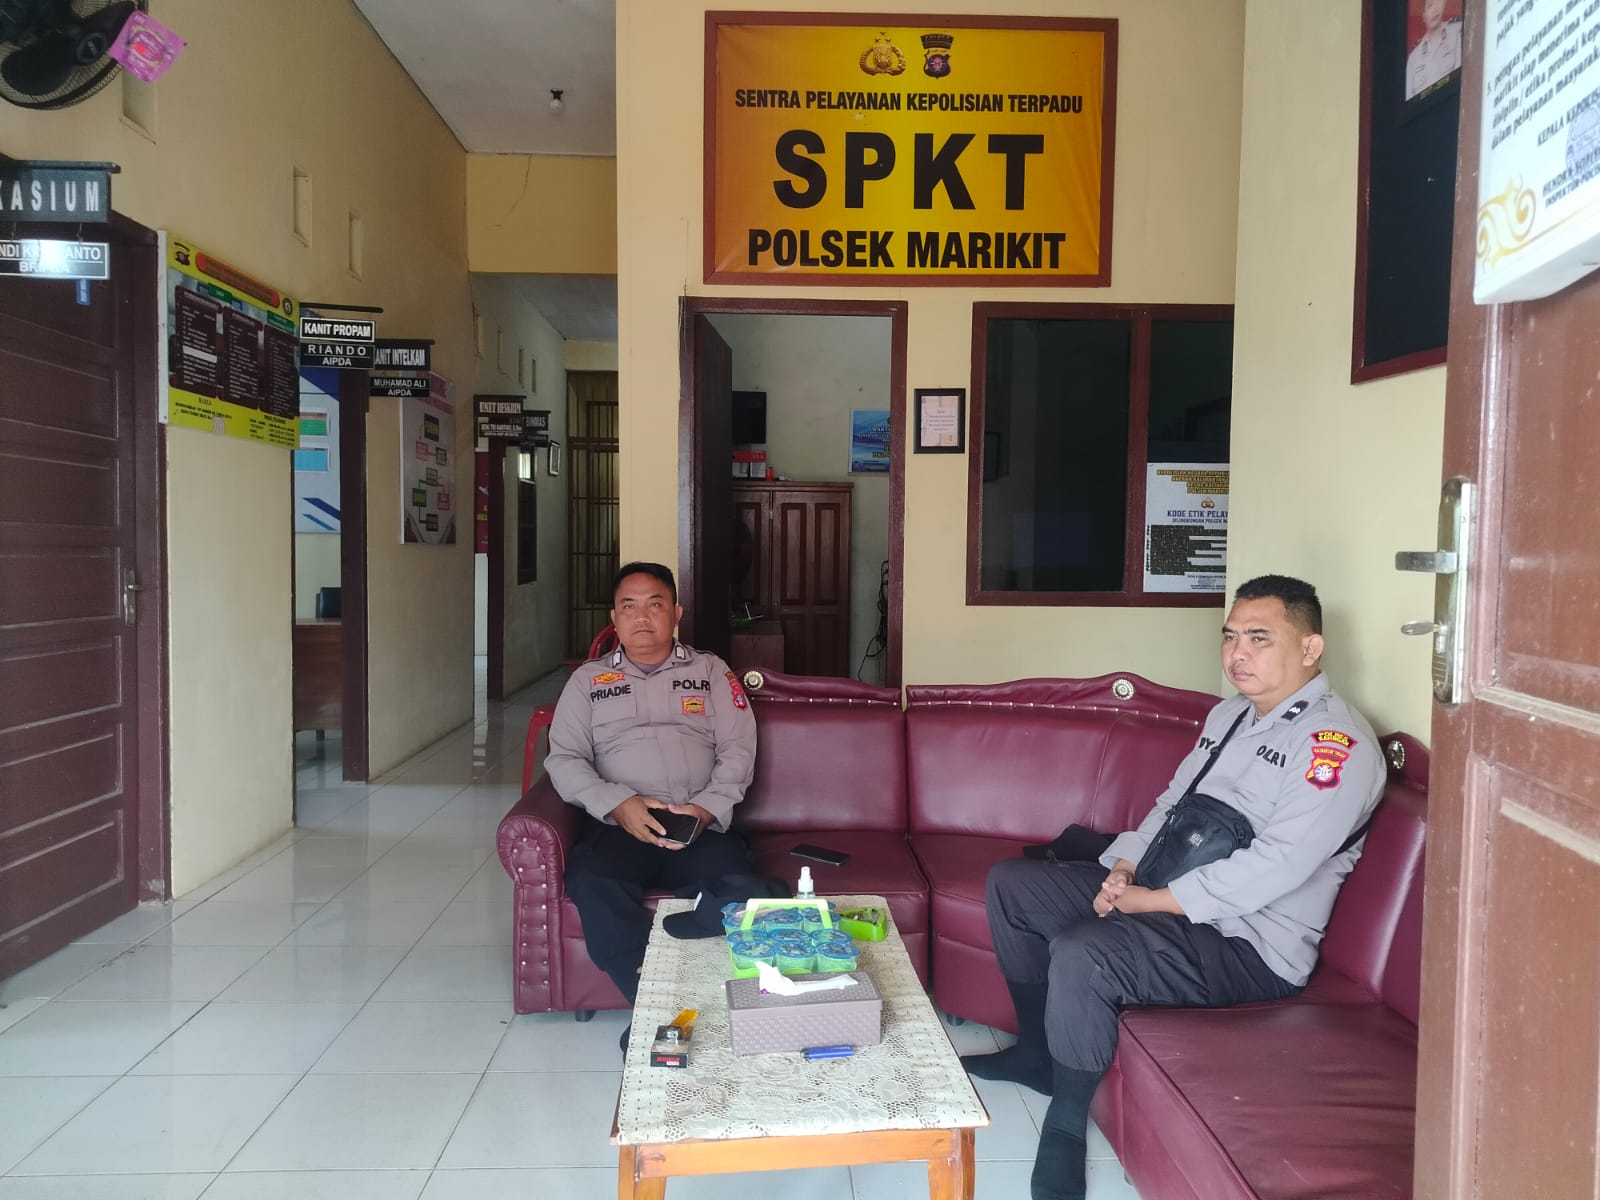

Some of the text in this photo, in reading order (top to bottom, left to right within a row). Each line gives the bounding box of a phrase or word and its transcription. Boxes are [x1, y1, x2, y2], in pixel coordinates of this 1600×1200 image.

[1522, 9, 1563, 62] pelayanan
[1513, 86, 1554, 135] pelayanan
[1555, 45, 1600, 94] masyarak
[735, 89, 1083, 113] SENTRA PELAYANAN KEPOLISIAN TERPADU
[773, 129, 1045, 210] SPKT
[748, 229, 1066, 269] POLSEK MARIKIT
[304, 323, 332, 335] KANIT
[333, 325, 371, 337] PROPAM
[308, 345, 367, 356] RIANDO
[374, 349, 425, 366] ANIT INTELKAM
[322, 357, 352, 366] AIPDA
[373, 379, 412, 387] MUHAMAD
[1167, 510, 1186, 518] KODE
[1189, 510, 1205, 518] ETIK
[590, 684, 631, 702] PRIADIE
[1256, 745, 1287, 768] OLRI
